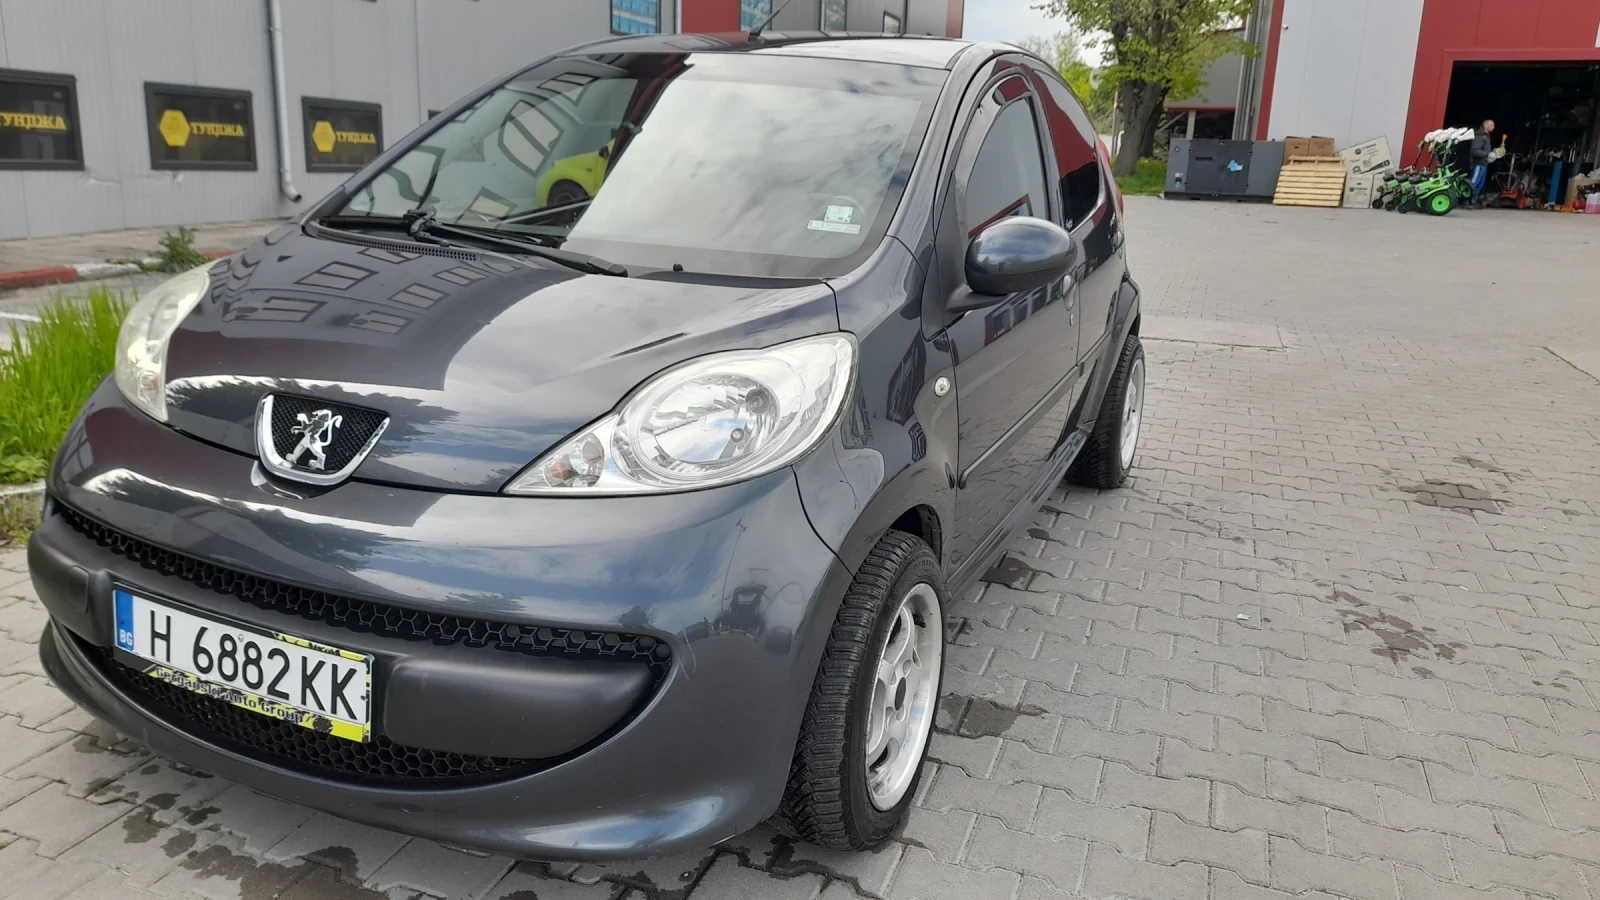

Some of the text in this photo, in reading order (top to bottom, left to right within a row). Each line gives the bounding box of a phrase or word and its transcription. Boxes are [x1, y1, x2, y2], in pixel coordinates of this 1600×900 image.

[190, 122, 245, 136] ТУНДЖА
[335, 131, 376, 144] ТУНДЖА
[119, 628, 133, 645] BG
[150, 609, 171, 662] H
[224, 690, 257, 709] Auto
[261, 702, 304, 724] Group
